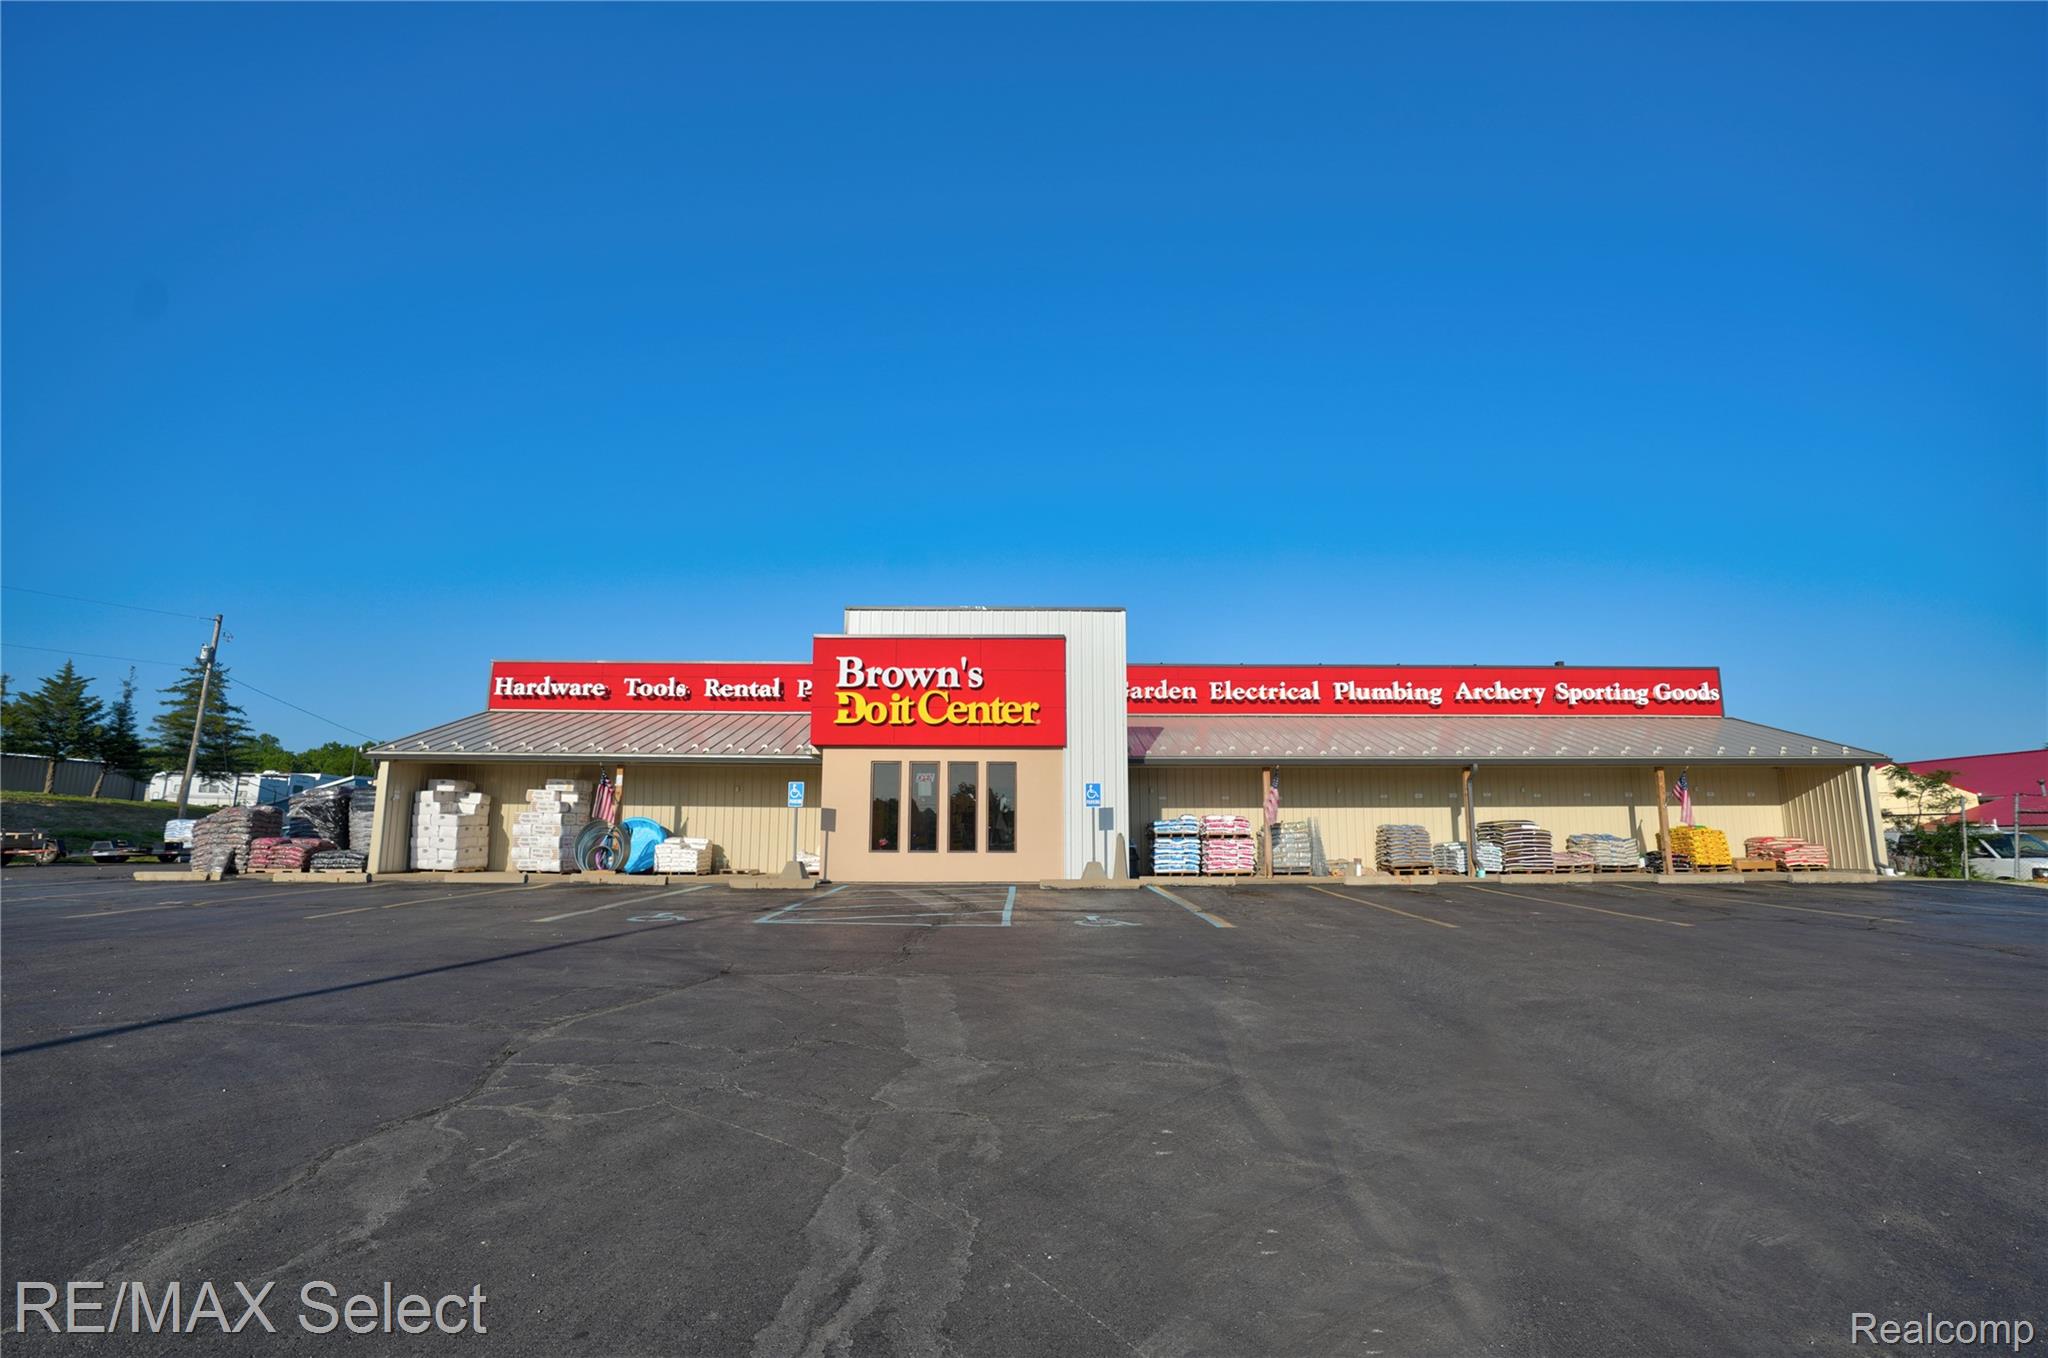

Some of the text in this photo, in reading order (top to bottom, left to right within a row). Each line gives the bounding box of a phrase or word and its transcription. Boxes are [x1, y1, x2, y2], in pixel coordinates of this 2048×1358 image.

[836, 656, 983, 688] Brown's
[494, 677, 606, 696] Hardware
[624, 677, 686, 697] Tools
[704, 677, 781, 698] Rental
[1209, 682, 1320, 700] Electrical
[1335, 682, 1443, 705] Plumbing
[1455, 682, 1546, 704] Archery
[1555, 683, 1650, 705] Sporting
[1652, 682, 1720, 701] Goods
[834, 691, 887, 724] Do
[918, 690, 1040, 724] Center
